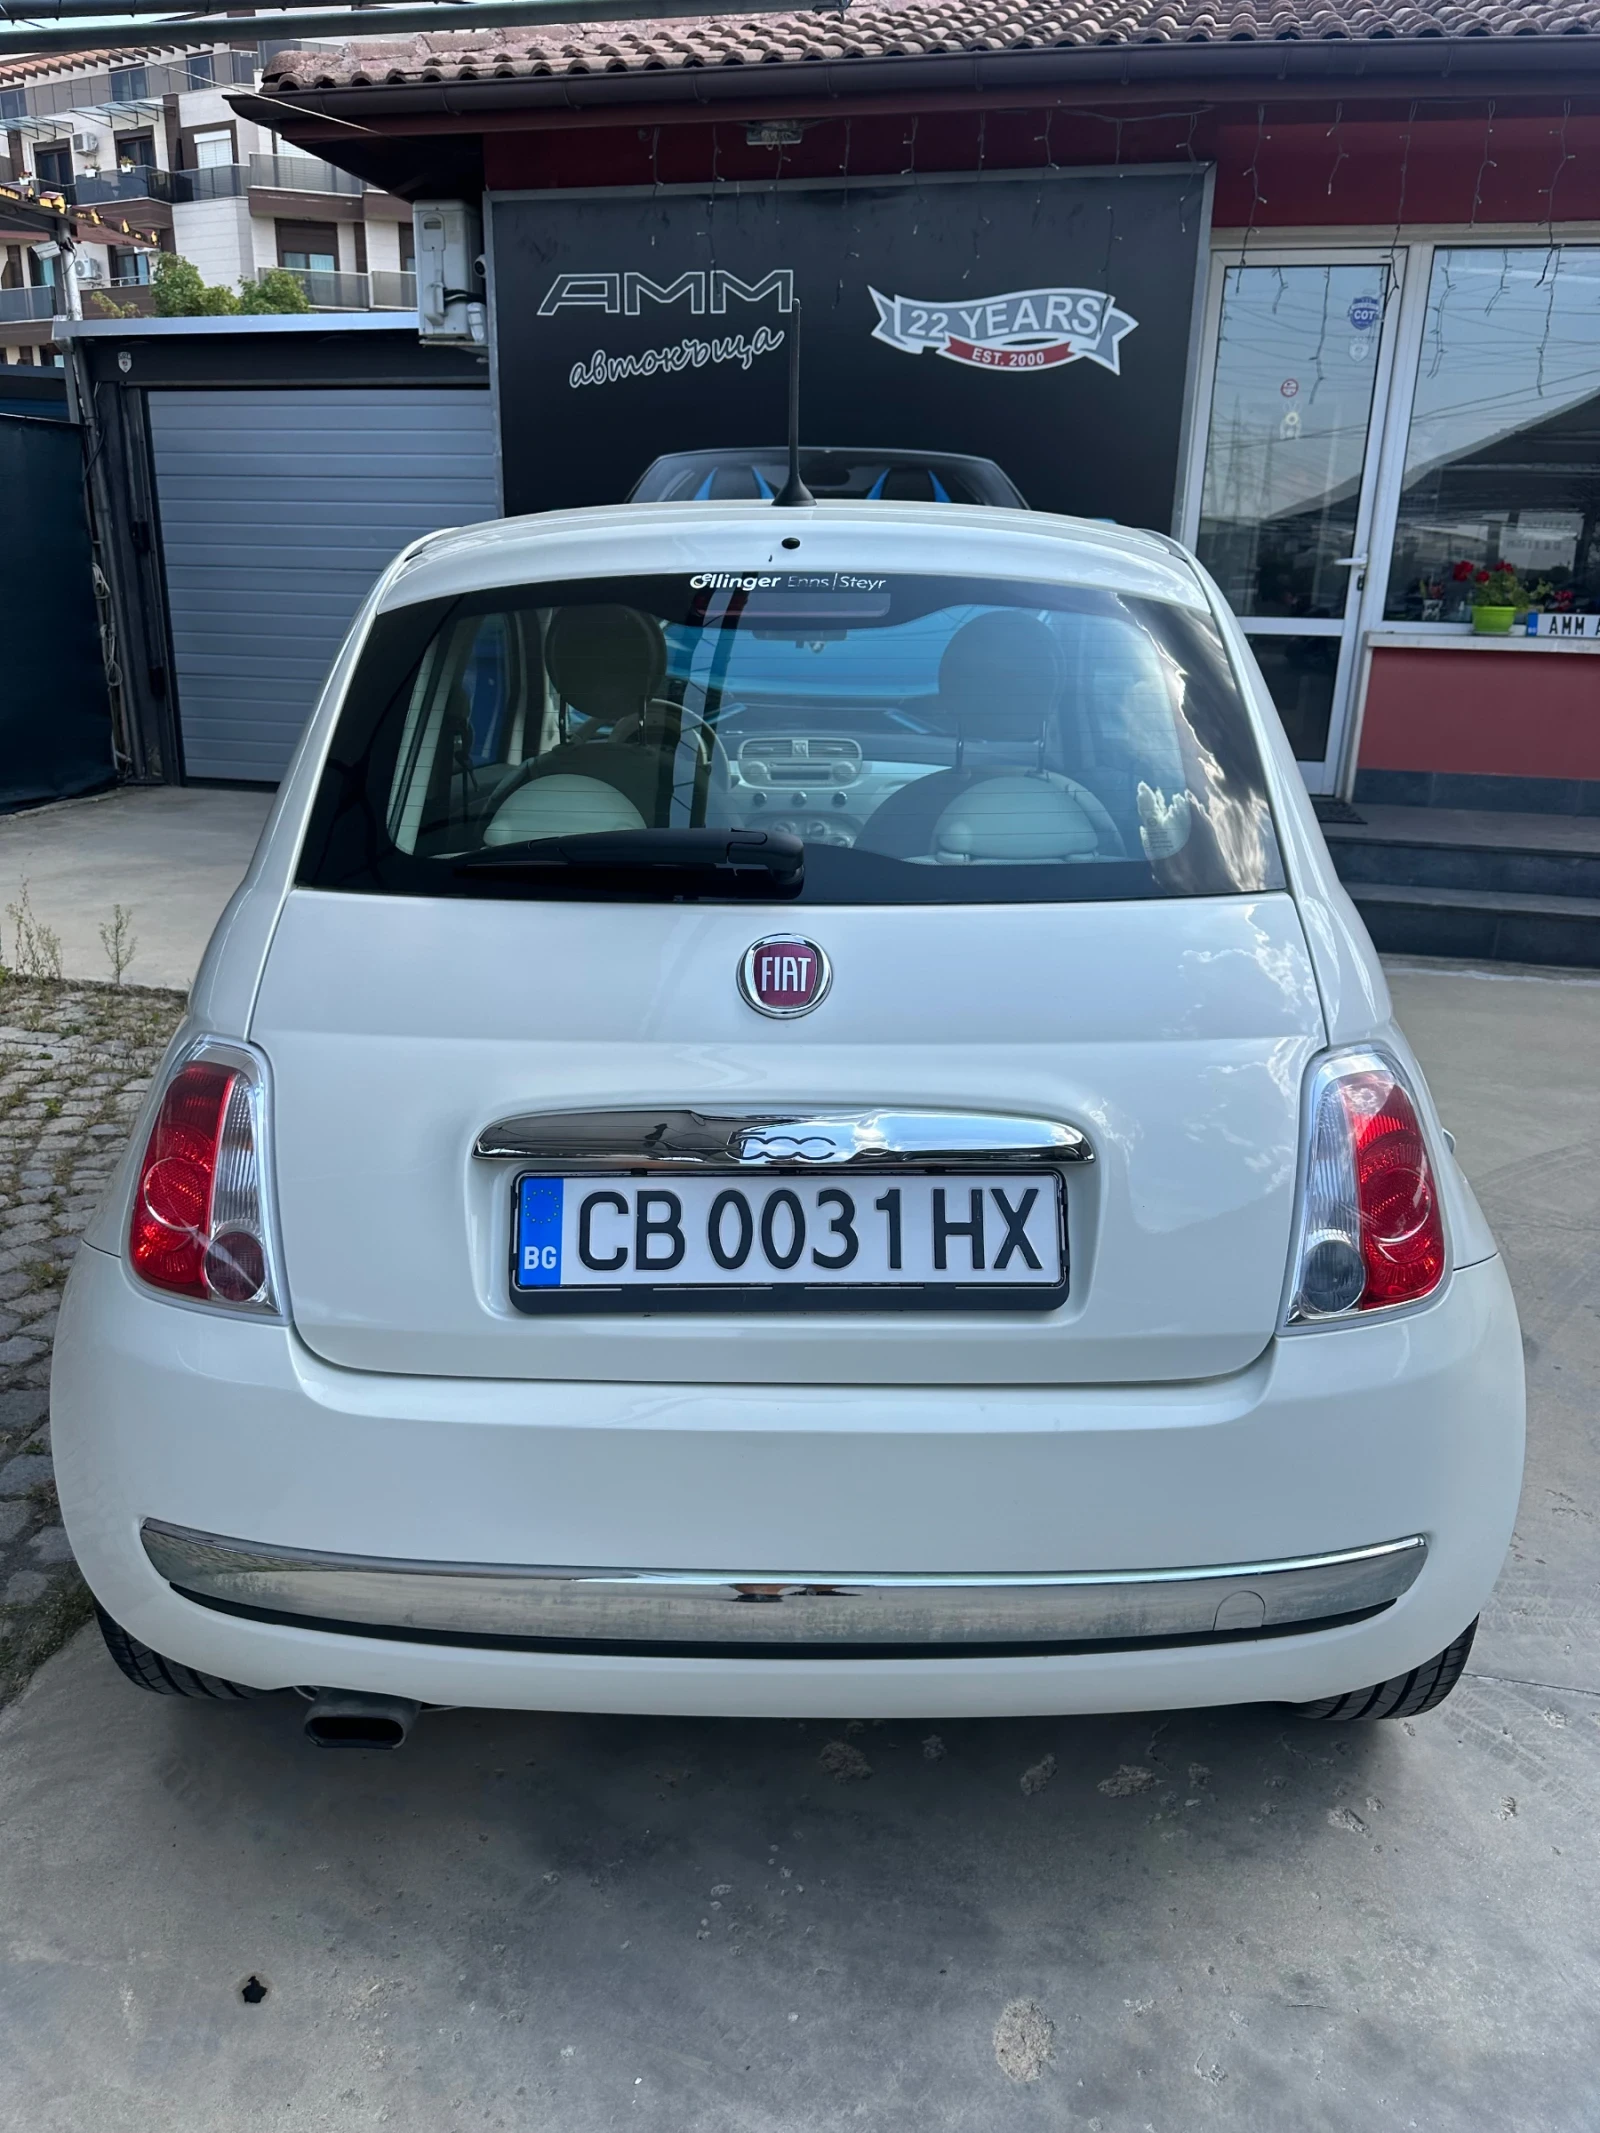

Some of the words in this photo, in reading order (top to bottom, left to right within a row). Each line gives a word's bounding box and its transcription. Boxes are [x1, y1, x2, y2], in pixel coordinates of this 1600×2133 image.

[537, 269, 793, 316] AMM
[908, 309, 949, 338] 22
[959, 295, 1101, 339] YEARS
[569, 325, 785, 388] автокъща
[972, 348, 1005, 366] EST.
[1009, 352, 1045, 366] 2000
[1549, 616, 1585, 636] AMM
[761, 956, 812, 992] FIAT
[726, 1131, 837, 1160] 500
[578, 1190, 686, 1271] CB
[707, 1188, 902, 1270] 0031
[932, 1188, 1044, 1270] HX
[523, 1246, 557, 1270] BG
